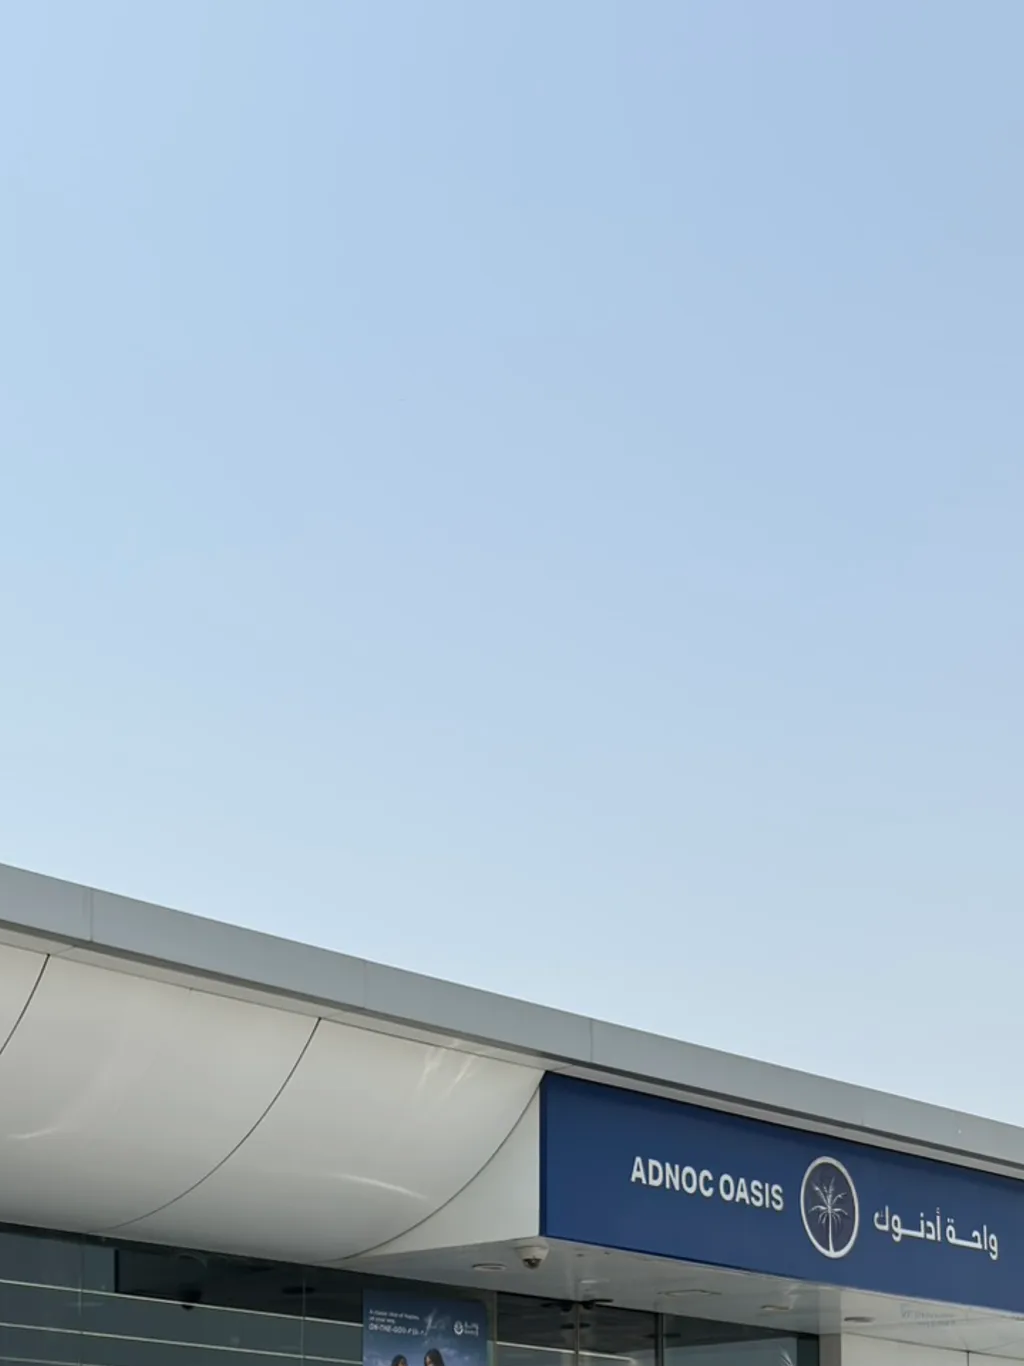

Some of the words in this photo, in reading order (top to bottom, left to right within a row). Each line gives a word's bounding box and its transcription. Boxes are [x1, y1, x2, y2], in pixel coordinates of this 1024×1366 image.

[631, 1156, 714, 1198] ADNOC
[719, 1174, 784, 1211] OASIS
[874, 1205, 942, 1242] أدنوك
[946, 1217, 998, 1260] واحة
